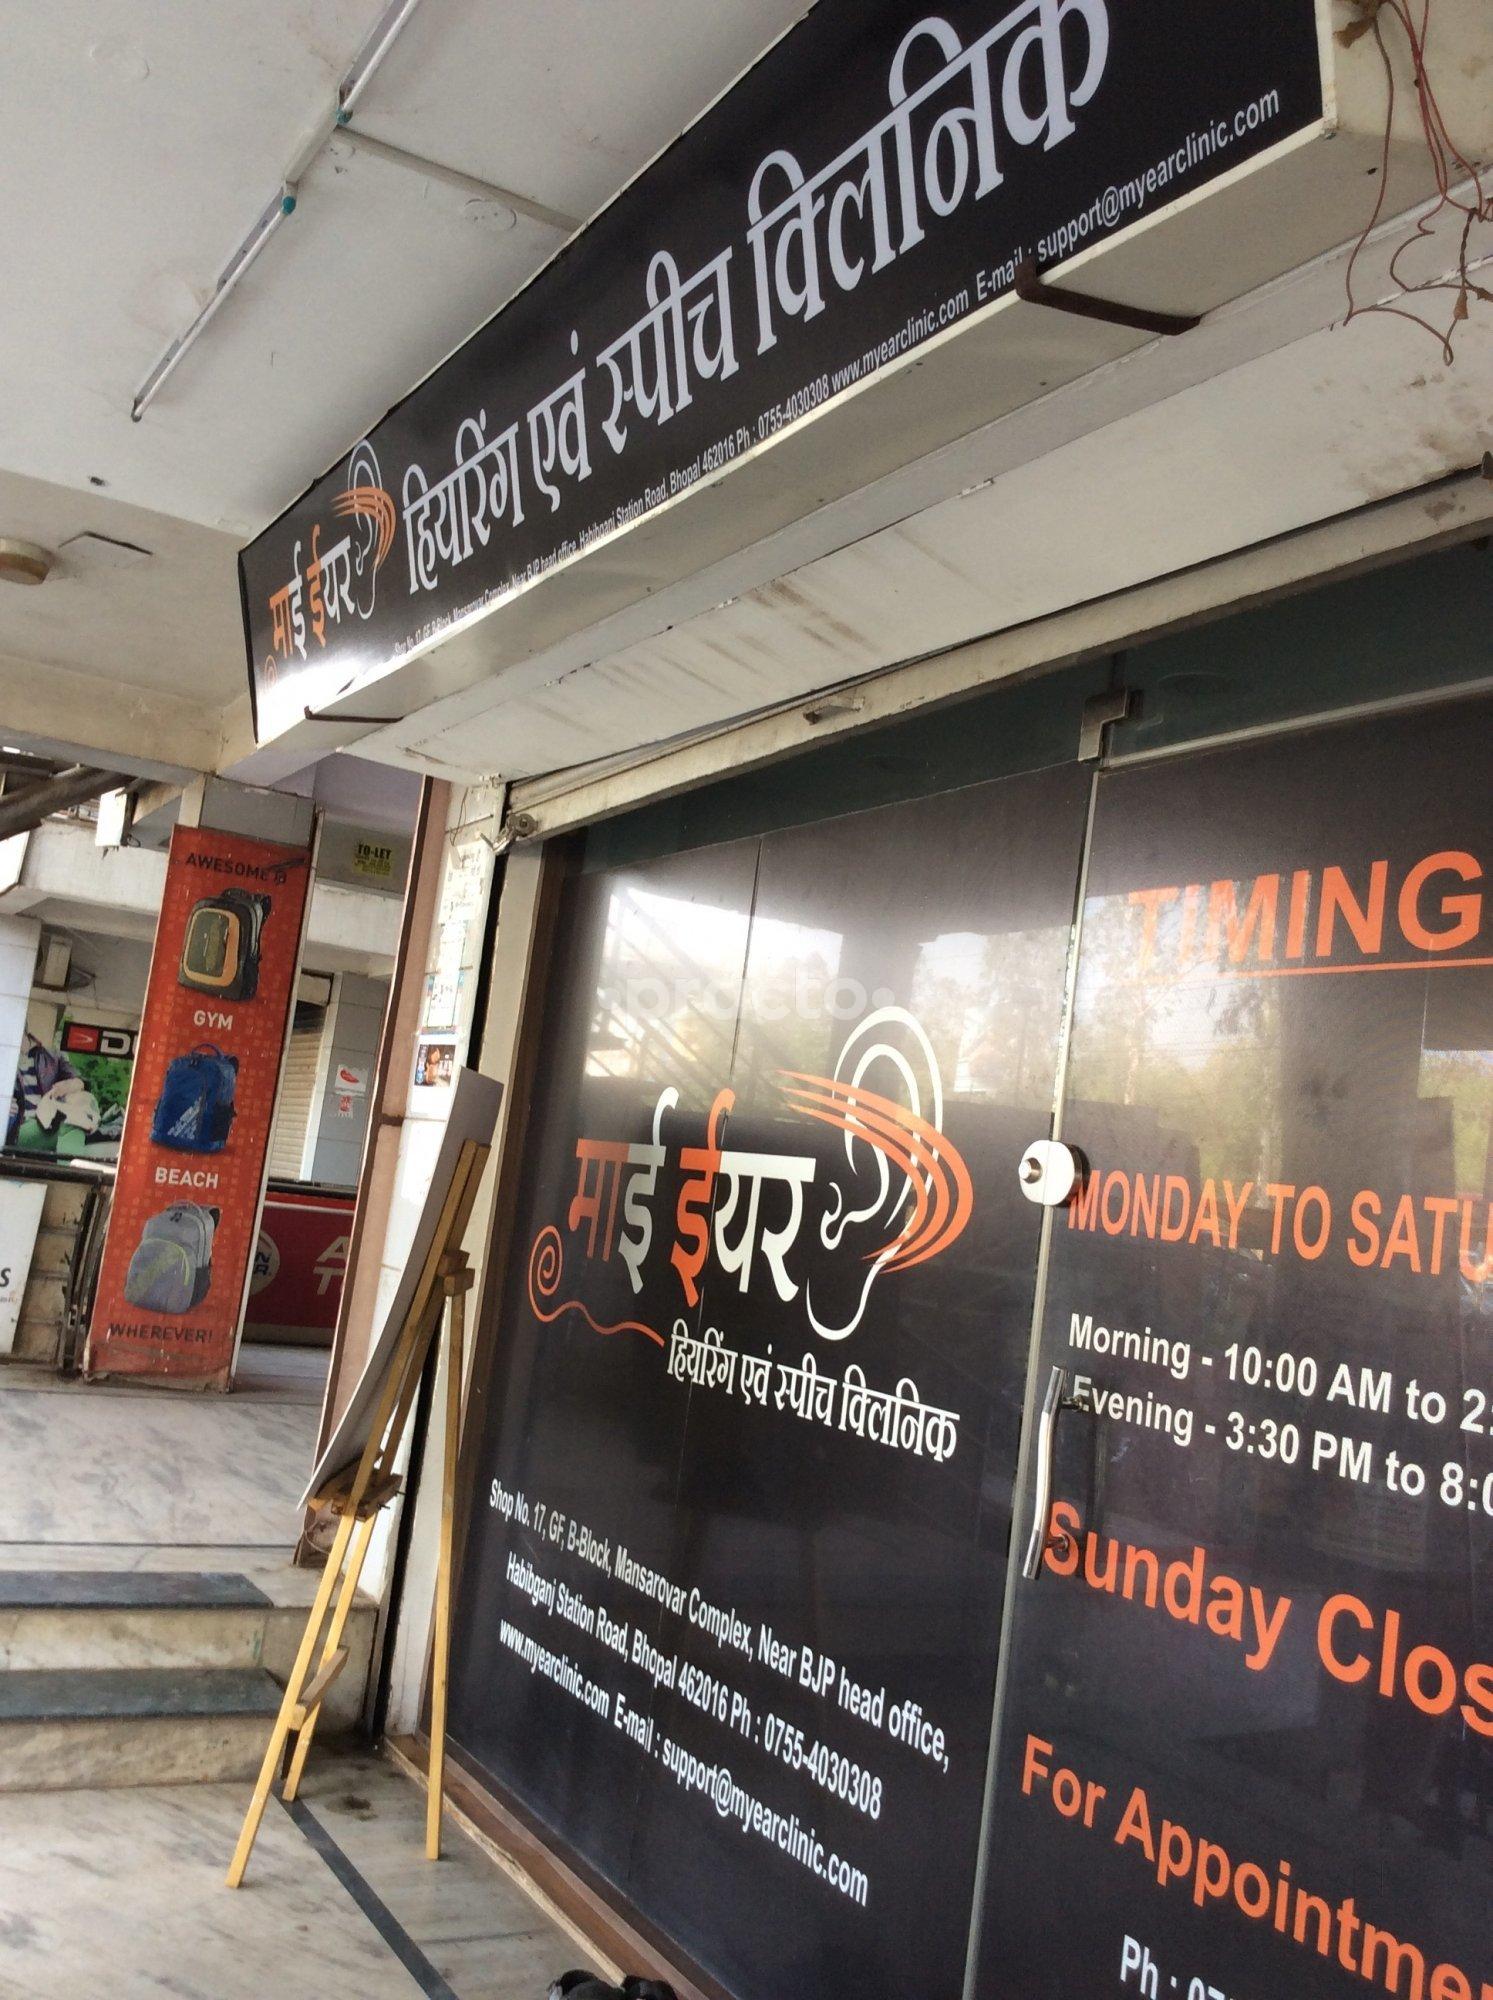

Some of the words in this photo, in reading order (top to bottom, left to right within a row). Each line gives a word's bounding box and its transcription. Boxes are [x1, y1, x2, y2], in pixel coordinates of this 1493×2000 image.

[403, 409, 525, 594] हियरिंग
[527, 330, 592, 511] एवं
[597, 251, 740, 454] स्पीच
[746, 0, 1109, 355] क्लिनिक
[616, 497, 644, 528] Station
[645, 479, 669, 508] Road,
[670, 455, 700, 495] Bhopal
[702, 435, 735, 473] 462016
[758, 374, 830, 439] 0755-4030308
[832, 290, 969, 393] www.myearclinic.com
[1038, 88, 1280, 263] support@myearclinic.com
[270, 540, 306, 661] माई
[307, 524, 355, 648] ईयर
[186, 852, 268, 881] AWESOME
[1128, 851, 1483, 972] TIMING
[193, 1010, 233, 1031] GYM
[154, 1167, 219, 1189] BEACH
[568, 1086, 679, 1294] माई
[670, 1088, 816, 1307] ईयर
[1068, 1169, 1254, 1251] MONDAY
[1266, 1183, 1331, 1260] TO
[1347, 1189, 1493, 1283] SATU
[109, 1322, 213, 1343] WHEREVER!
[667, 1318, 739, 1394] हियरिंग
[740, 1344, 772, 1405] एवं
[774, 1352, 837, 1426] स्पीच
[838, 1363, 960, 1463] क्लिनिक
[1069, 1313, 1191, 1379] Morning
[1224, 1343, 1317, 1397] 10:00
[1326, 1364, 1392, 1414] AM
[1406, 1379, 1446, 1424] to
[1073, 1374, 1194, 1447] Evening
[1225, 1412, 1300, 1465] 3:30
[1312, 1431, 1372, 1484] PM
[1385, 1449, 1425, 1496] to
[489, 1477, 514, 1522] Shop
[515, 1491, 530, 1527] No.
[533, 1501, 546, 1541] 17,
[548, 1509, 565, 1550] GF,
[567, 1518, 612, 1578] B-Block,
[615, 1544, 687, 1617] Mansarovar
[688, 1587, 753, 1663] Complex,
[758, 1624, 798, 1678] Near
[799, 1646, 835, 1697] BJP
[838, 1667, 884, 1728] head
[889, 1700, 950, 1774] office,
[506, 1551, 557, 1617] Habibganj
[556, 1586, 595, 1633] Station
[597, 1607, 628, 1663] Road,
[632, 1628, 676, 1691] Bhopal
[678, 1663, 728, 1722] 462016
[731, 1691, 751, 1739] Ph
[764, 1713, 883, 1821] 0755-4030308
[1044, 1501, 1292, 1672] Sunday
[1317, 1593, 1493, 1737] Clos
[499, 1618, 610, 1720] www.myearclinic.com
[613, 1692, 653, 1760] E-mail
[662, 1737, 868, 1907] support@myearclinic.com
[1021, 1734, 1106, 1828] For
[1114, 1786, 1493, 2000] Appointme
[1119, 1934, 1159, 2000] Ph
